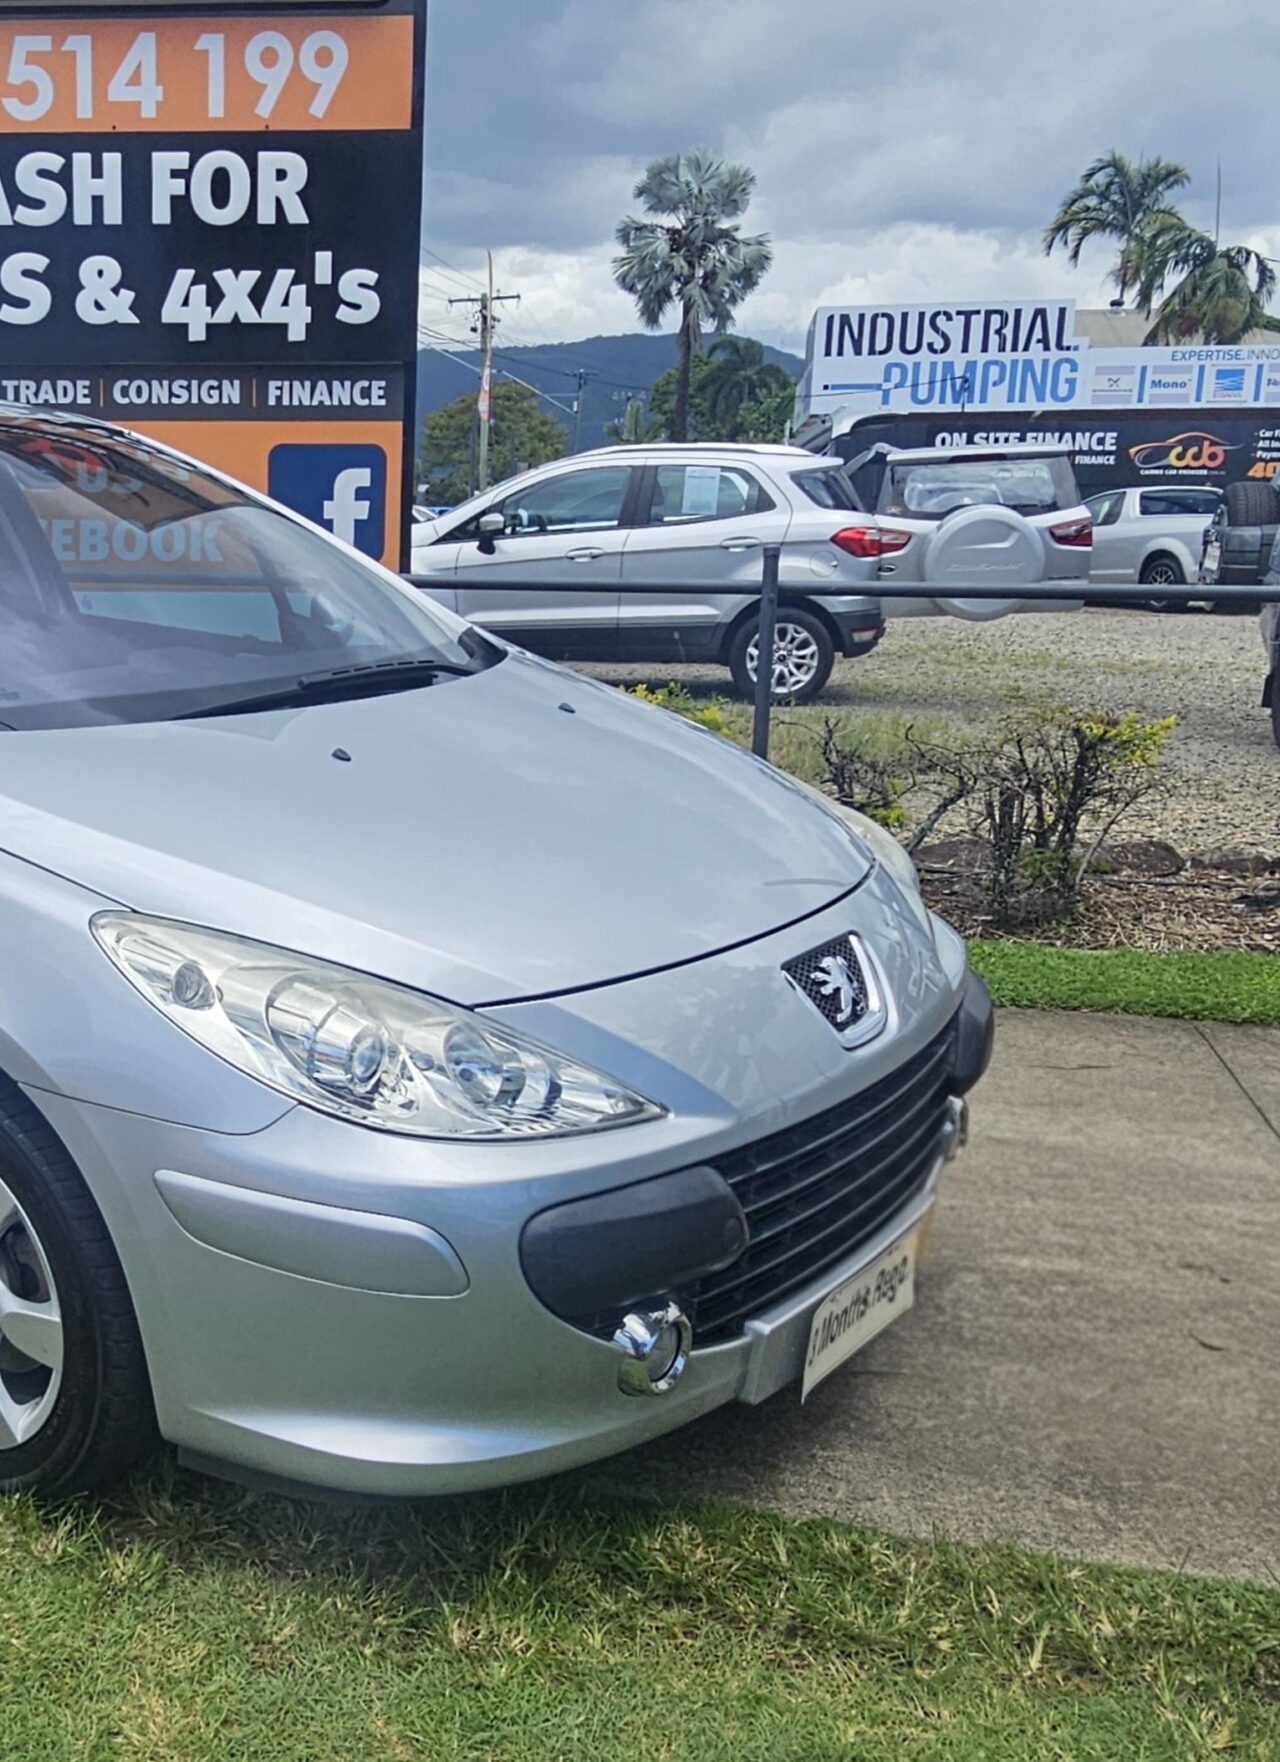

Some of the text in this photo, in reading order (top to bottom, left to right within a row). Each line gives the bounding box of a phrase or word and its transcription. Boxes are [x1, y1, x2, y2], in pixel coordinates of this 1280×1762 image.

[1, 32, 163, 121] 514
[194, 30, 349, 118] 199
[151, 150, 310, 227] FOR
[75, 254, 140, 325] &
[2, 380, 91, 405] TRADE
[112, 379, 242, 406] CONSIGN
[268, 380, 387, 406] FINANCE
[881, 357, 1080, 406] PUMPING
[935, 432, 1118, 450] ON SITE FINANCE
[1075, 455, 1116, 465] FINANCE
